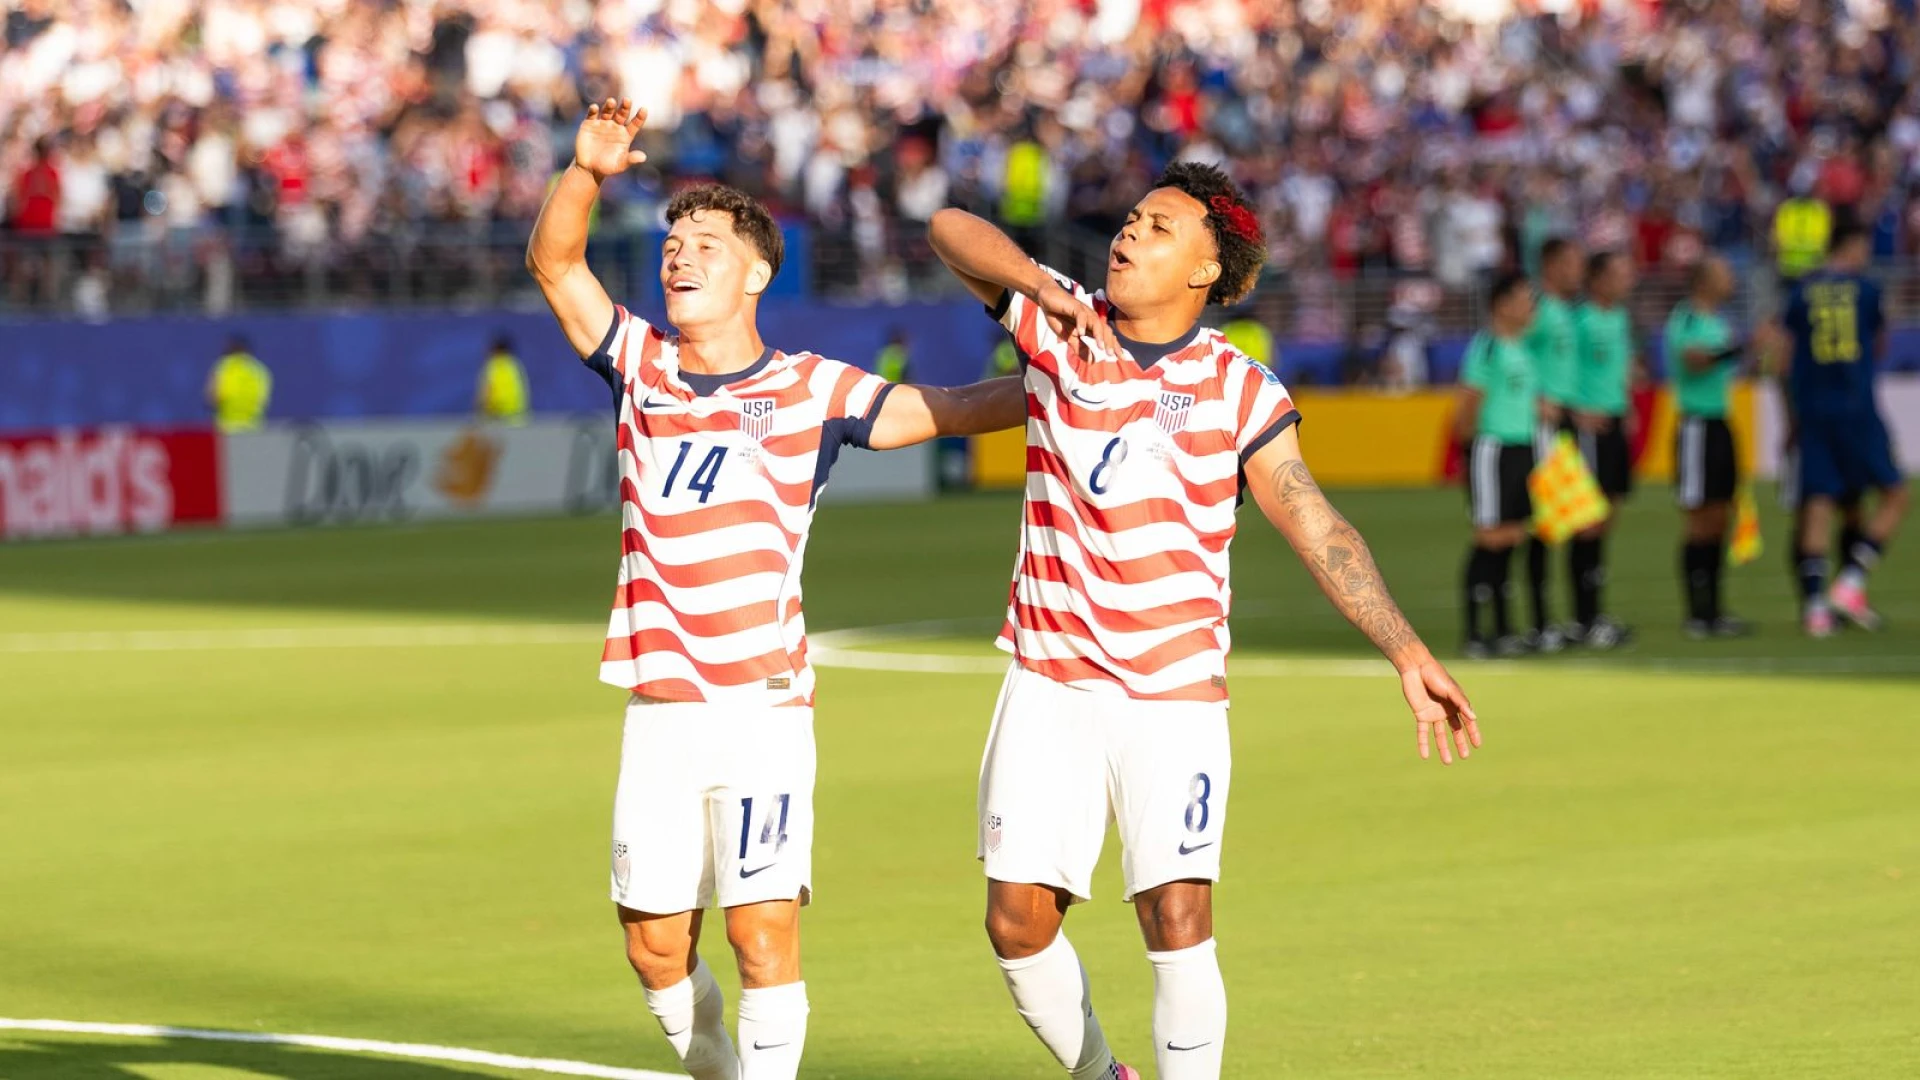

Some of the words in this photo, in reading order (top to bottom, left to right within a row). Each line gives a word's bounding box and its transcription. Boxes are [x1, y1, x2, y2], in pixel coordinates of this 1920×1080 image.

[743, 400, 773, 417] USA
[1160, 393, 1192, 411] USA
[661, 441, 728, 503] 14
[1089, 436, 1129, 496] 8
[1184, 772, 1211, 833] 8
[739, 793, 790, 859] 14
[987, 815, 1002, 830] SA
[613, 843, 628, 858] SA
